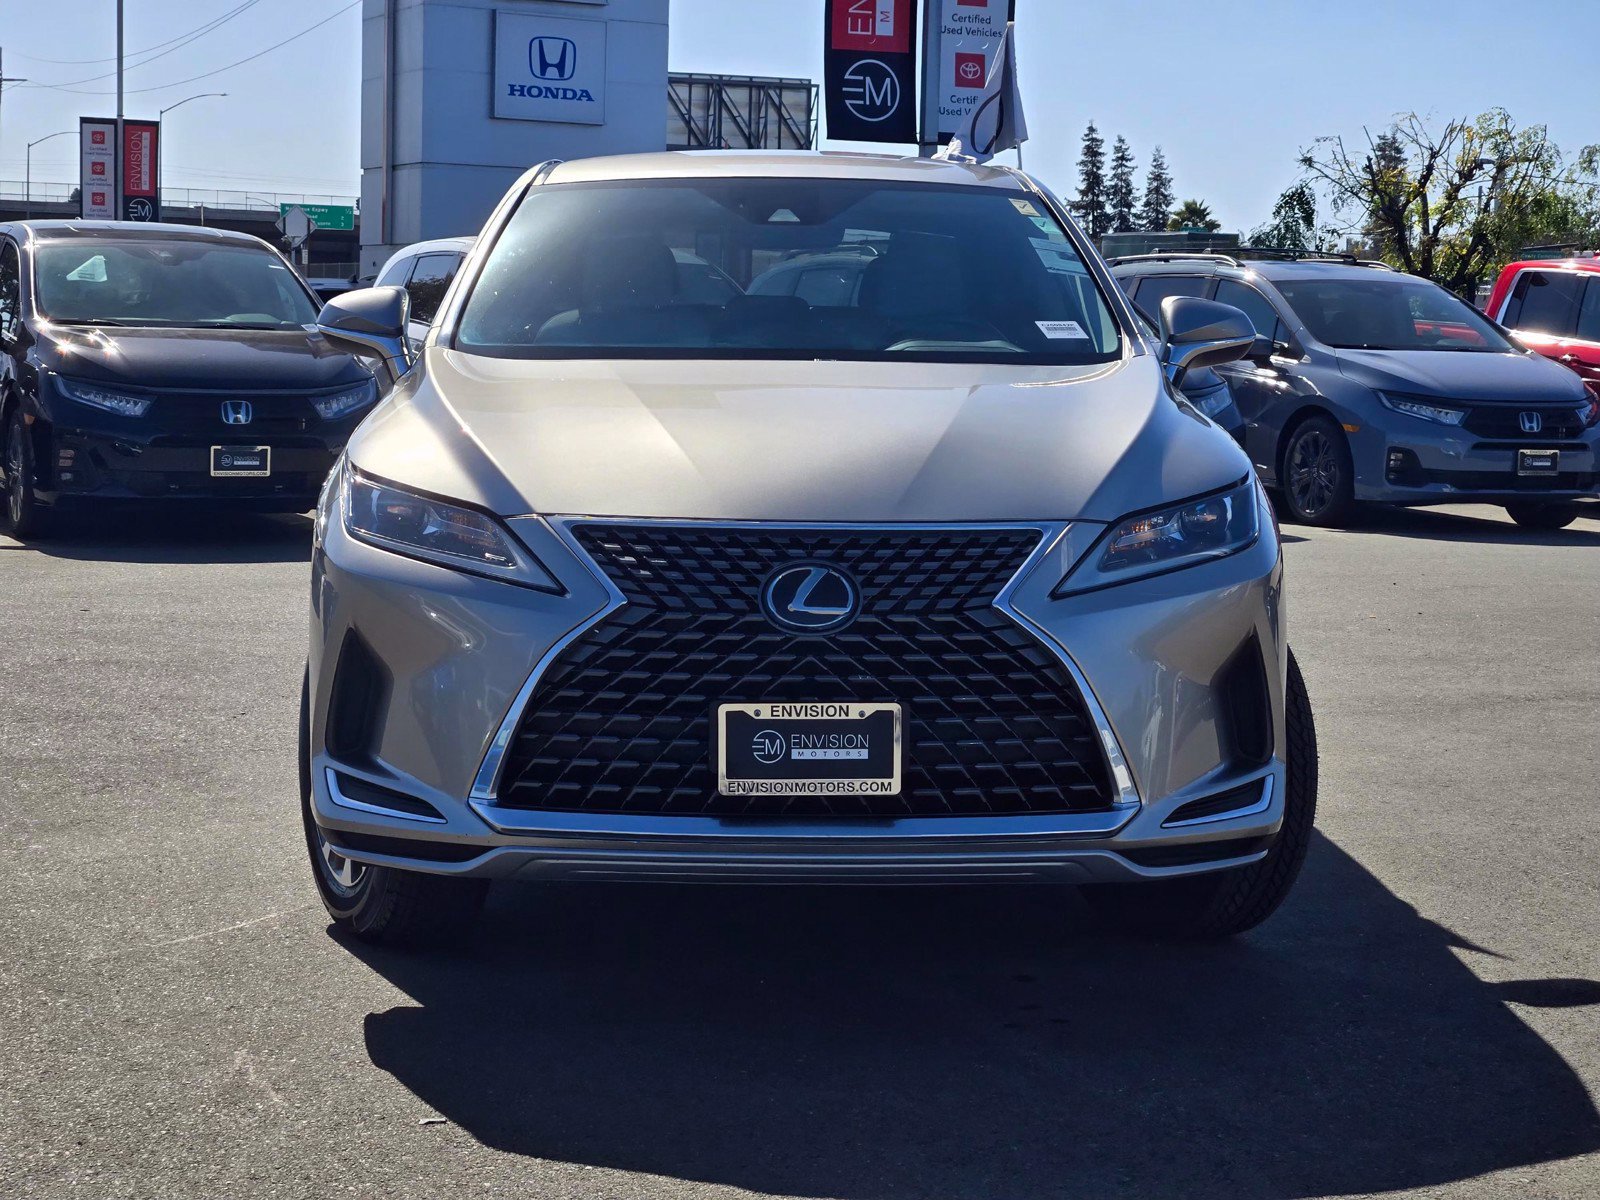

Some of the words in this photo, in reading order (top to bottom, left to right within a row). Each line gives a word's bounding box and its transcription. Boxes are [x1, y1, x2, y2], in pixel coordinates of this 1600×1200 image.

[951, 13, 992, 25] Certified
[940, 25, 963, 35] Used
[965, 26, 1003, 38] Vehicles
[507, 83, 595, 102] HONDA
[950, 94, 980, 105] Certif
[938, 106, 962, 116] Used
[130, 131, 142, 190] ENVISION
[770, 705, 850, 718] ENVISION
[790, 734, 869, 748] ENVISION
[727, 781, 892, 793] ENVISIONMOTORS.COM
